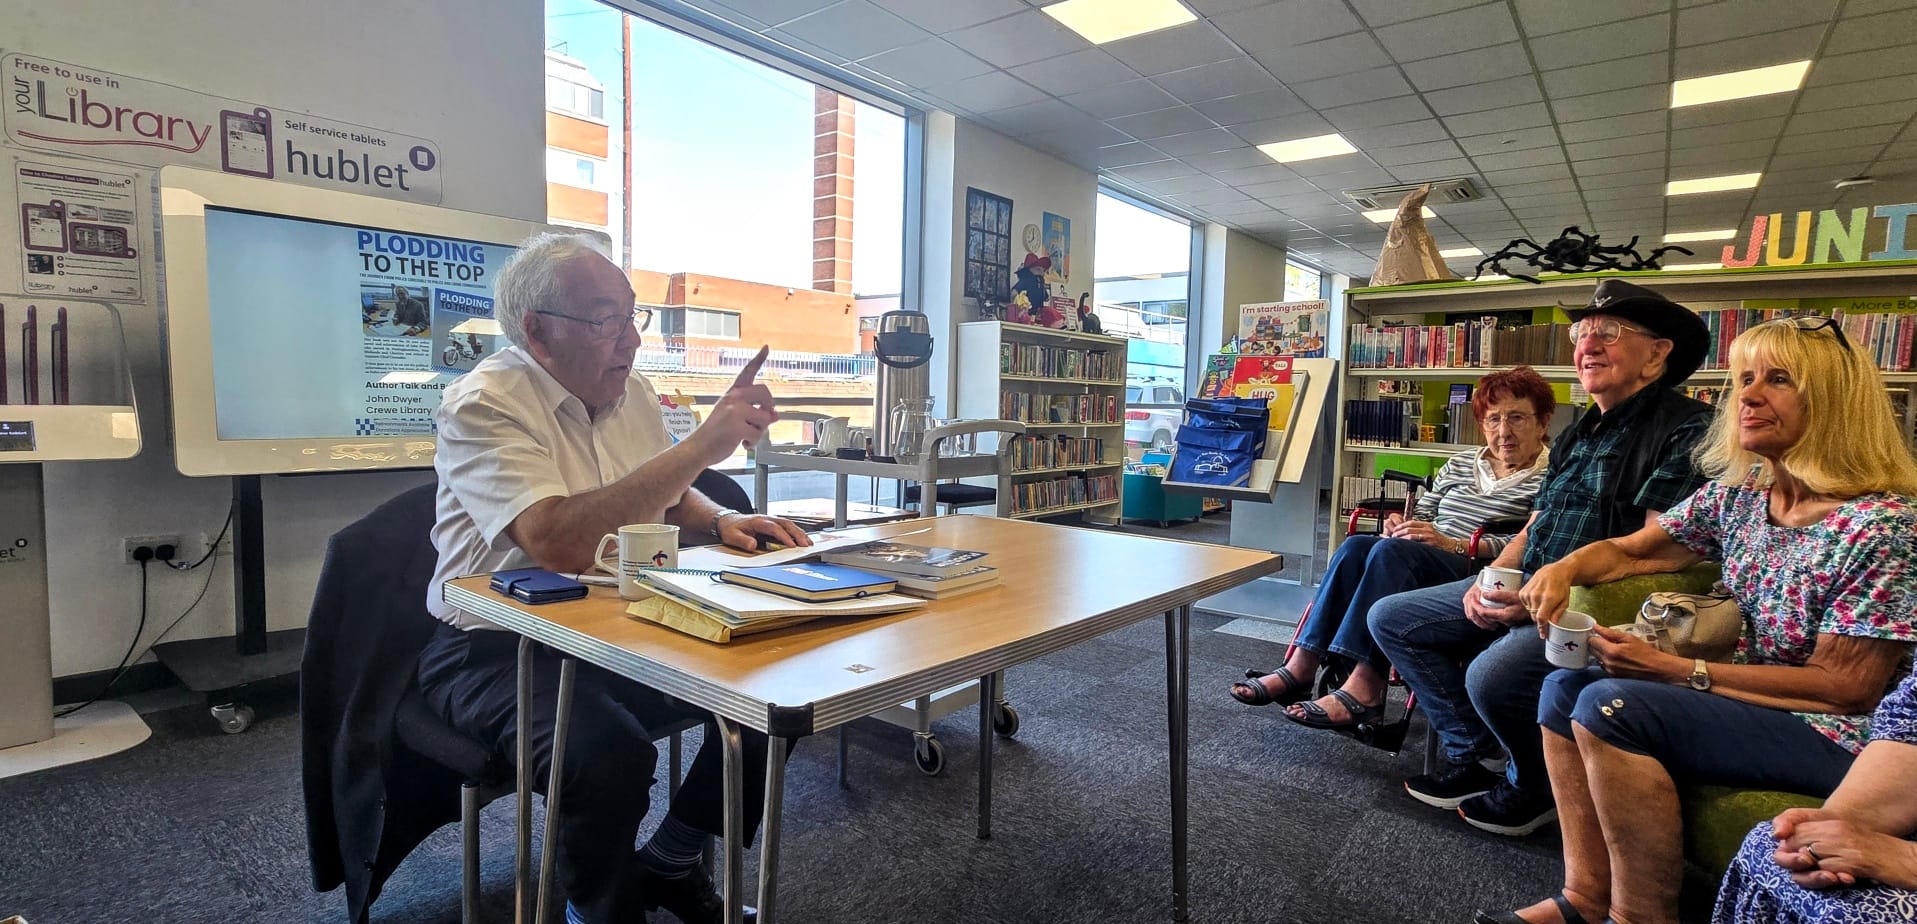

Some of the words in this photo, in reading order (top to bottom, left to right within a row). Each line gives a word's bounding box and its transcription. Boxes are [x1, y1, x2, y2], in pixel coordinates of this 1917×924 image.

[14, 58, 50, 74] Free
[55, 66, 71, 78] to
[76, 73, 102, 85] use
[106, 76, 120, 89] in
[14, 76, 37, 115] your
[36, 79, 212, 153] Library
[285, 119, 308, 132] Self
[309, 125, 348, 140] service
[350, 132, 387, 147] tablets
[286, 140, 410, 192] hublet
[100, 179, 126, 189] hublet
[1720, 202, 1917, 268] JUNI
[357, 230, 485, 264] PLODDING
[359, 252, 392, 273] TO
[395, 256, 440, 278] THE
[443, 262, 485, 281] TOP
[440, 292, 489, 309] PLODDING
[440, 300, 452, 310] TO
[453, 302, 471, 313] THE
[471, 306, 489, 316] TOP
[1257, 304, 1291, 314] starting
[1292, 302, 1325, 312] school!
[1851, 300, 1893, 311] More
[365, 381, 398, 390] Author
[400, 382, 419, 390] Talk
[421, 382, 439, 390] and
[366, 395, 390, 403] John
[392, 395, 423, 405] Dwyer
[366, 406, 398, 414] Crewe
[400, 406, 432, 415] Library
